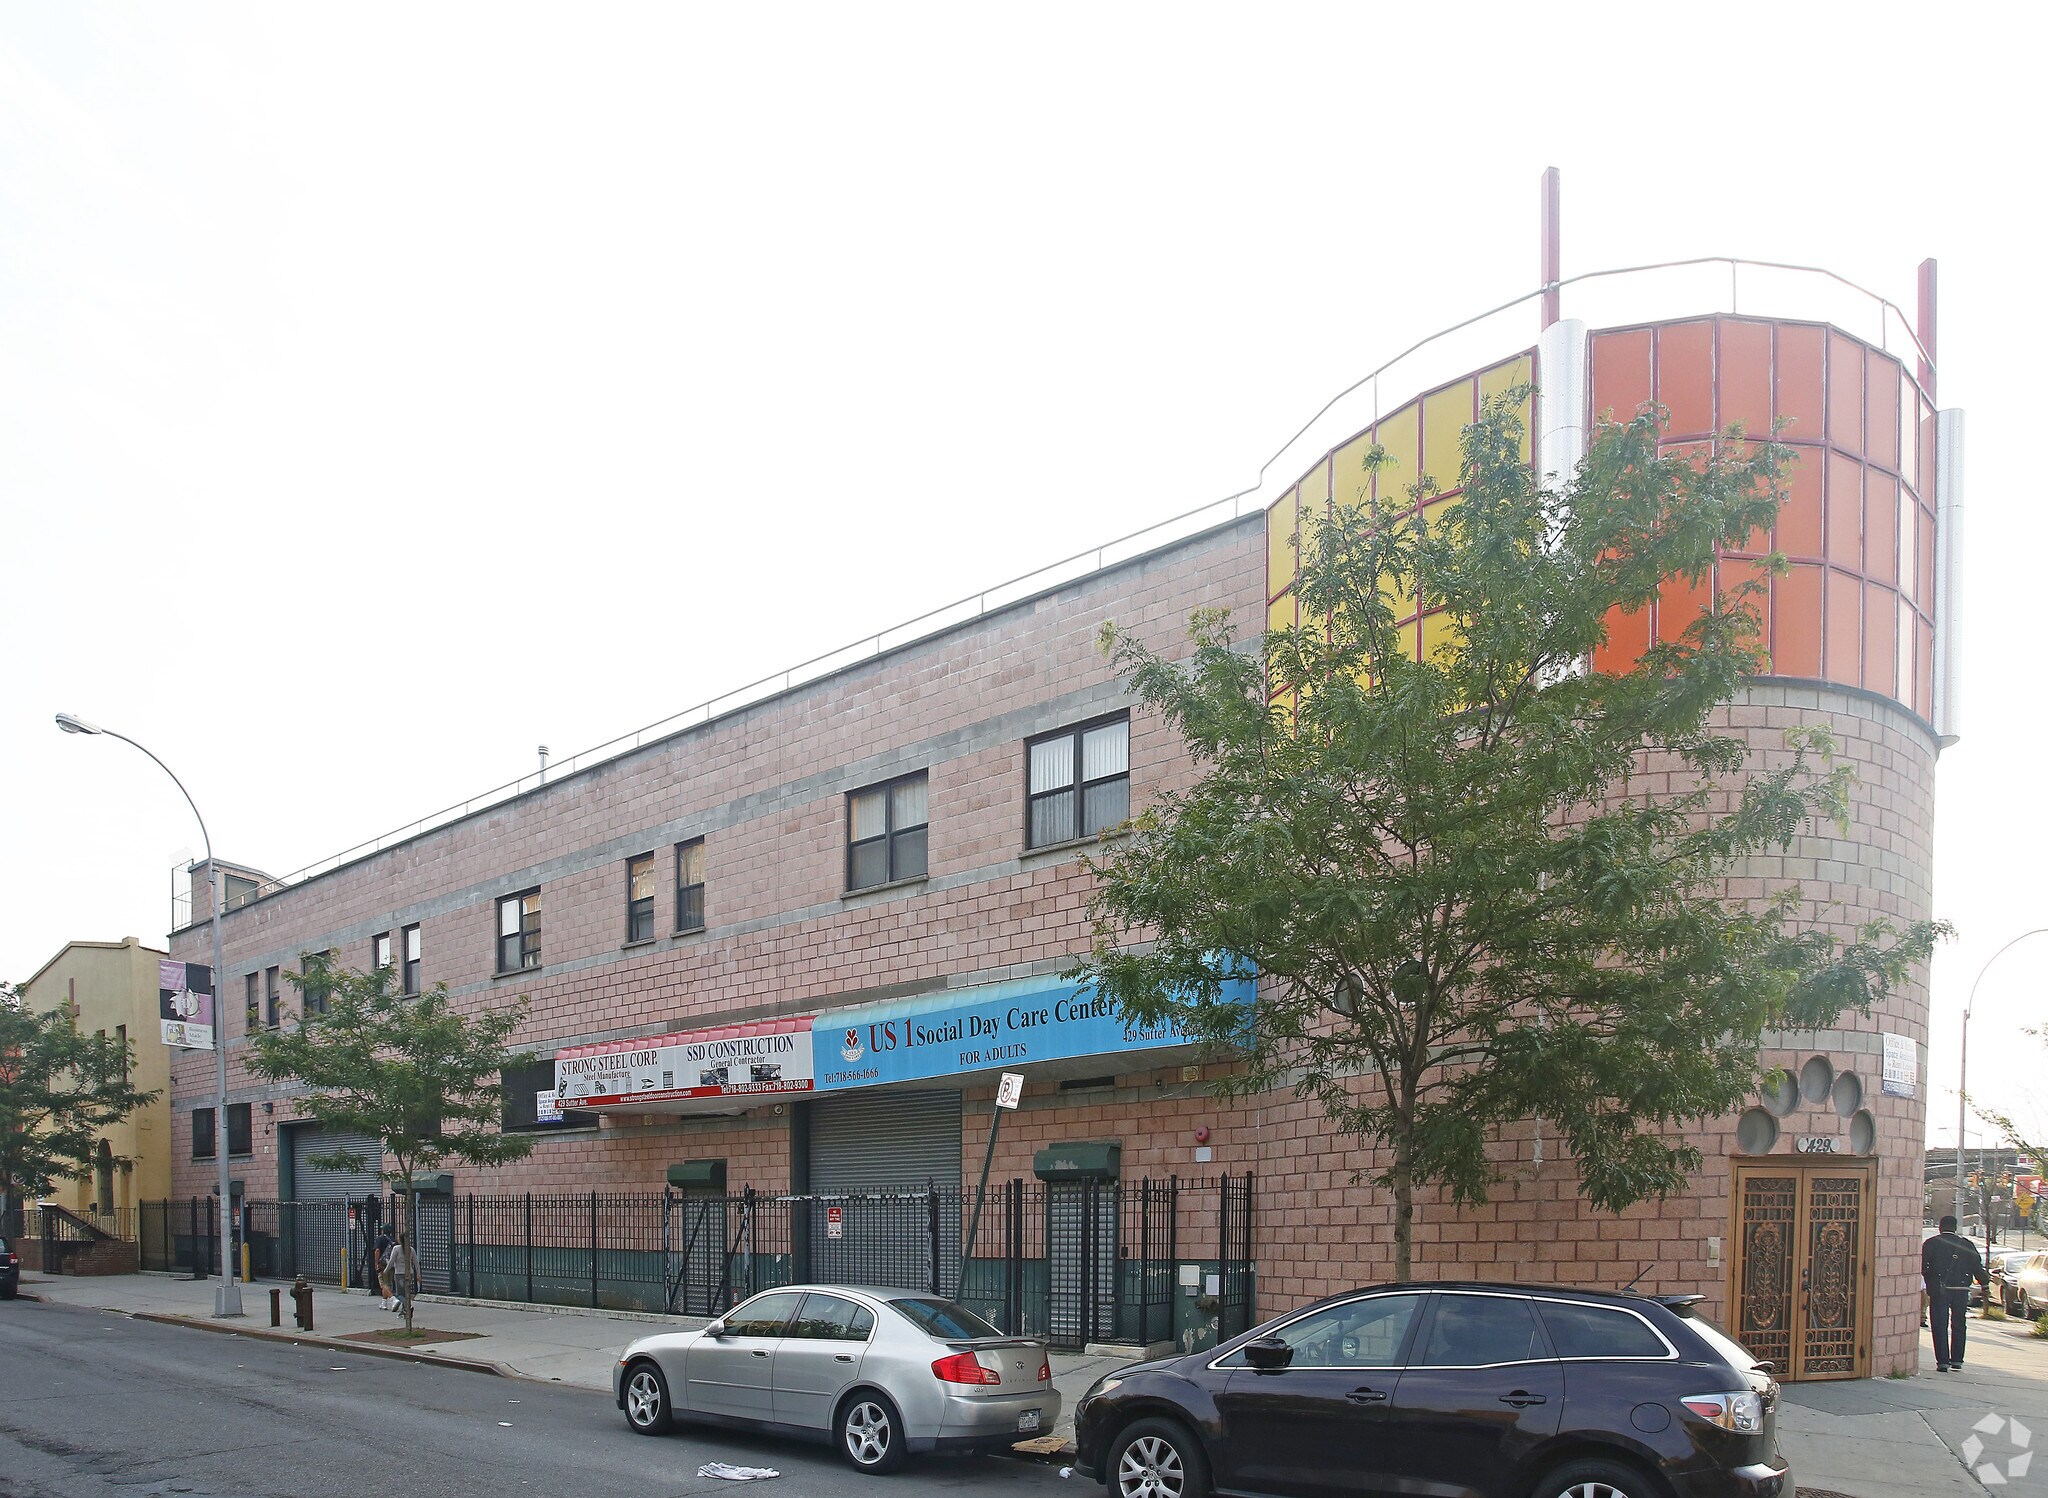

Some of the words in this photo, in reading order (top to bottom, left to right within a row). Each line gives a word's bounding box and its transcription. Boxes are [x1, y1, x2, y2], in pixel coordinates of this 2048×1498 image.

[868, 1021, 897, 1053] US
[904, 1019, 914, 1048] 1
[916, 1019, 963, 1047] Social
[969, 1014, 1000, 1040] Day
[1006, 1007, 1049, 1030] Care
[1055, 998, 1116, 1023] Center
[1123, 1029, 1137, 1042] 429
[687, 1044, 706, 1061] SSD
[708, 1035, 794, 1060] CONSTRUCTION
[960, 1050, 980, 1065] FOR
[984, 1042, 1027, 1061] ADULTS
[561, 1057, 596, 1076] STRONG
[598, 1054, 628, 1071] STEEL
[630, 1050, 658, 1068] CORP.
[710, 1058, 733, 1069] General
[733, 1055, 765, 1067] Contractor
[583, 1071, 597, 1082] Steel
[597, 1070, 631, 1081] Manufacture
[824, 1067, 879, 1083] Tel:718-566-1666
[557, 1099, 566, 1107] 429
[1807, 1138, 1830, 1152] 429
